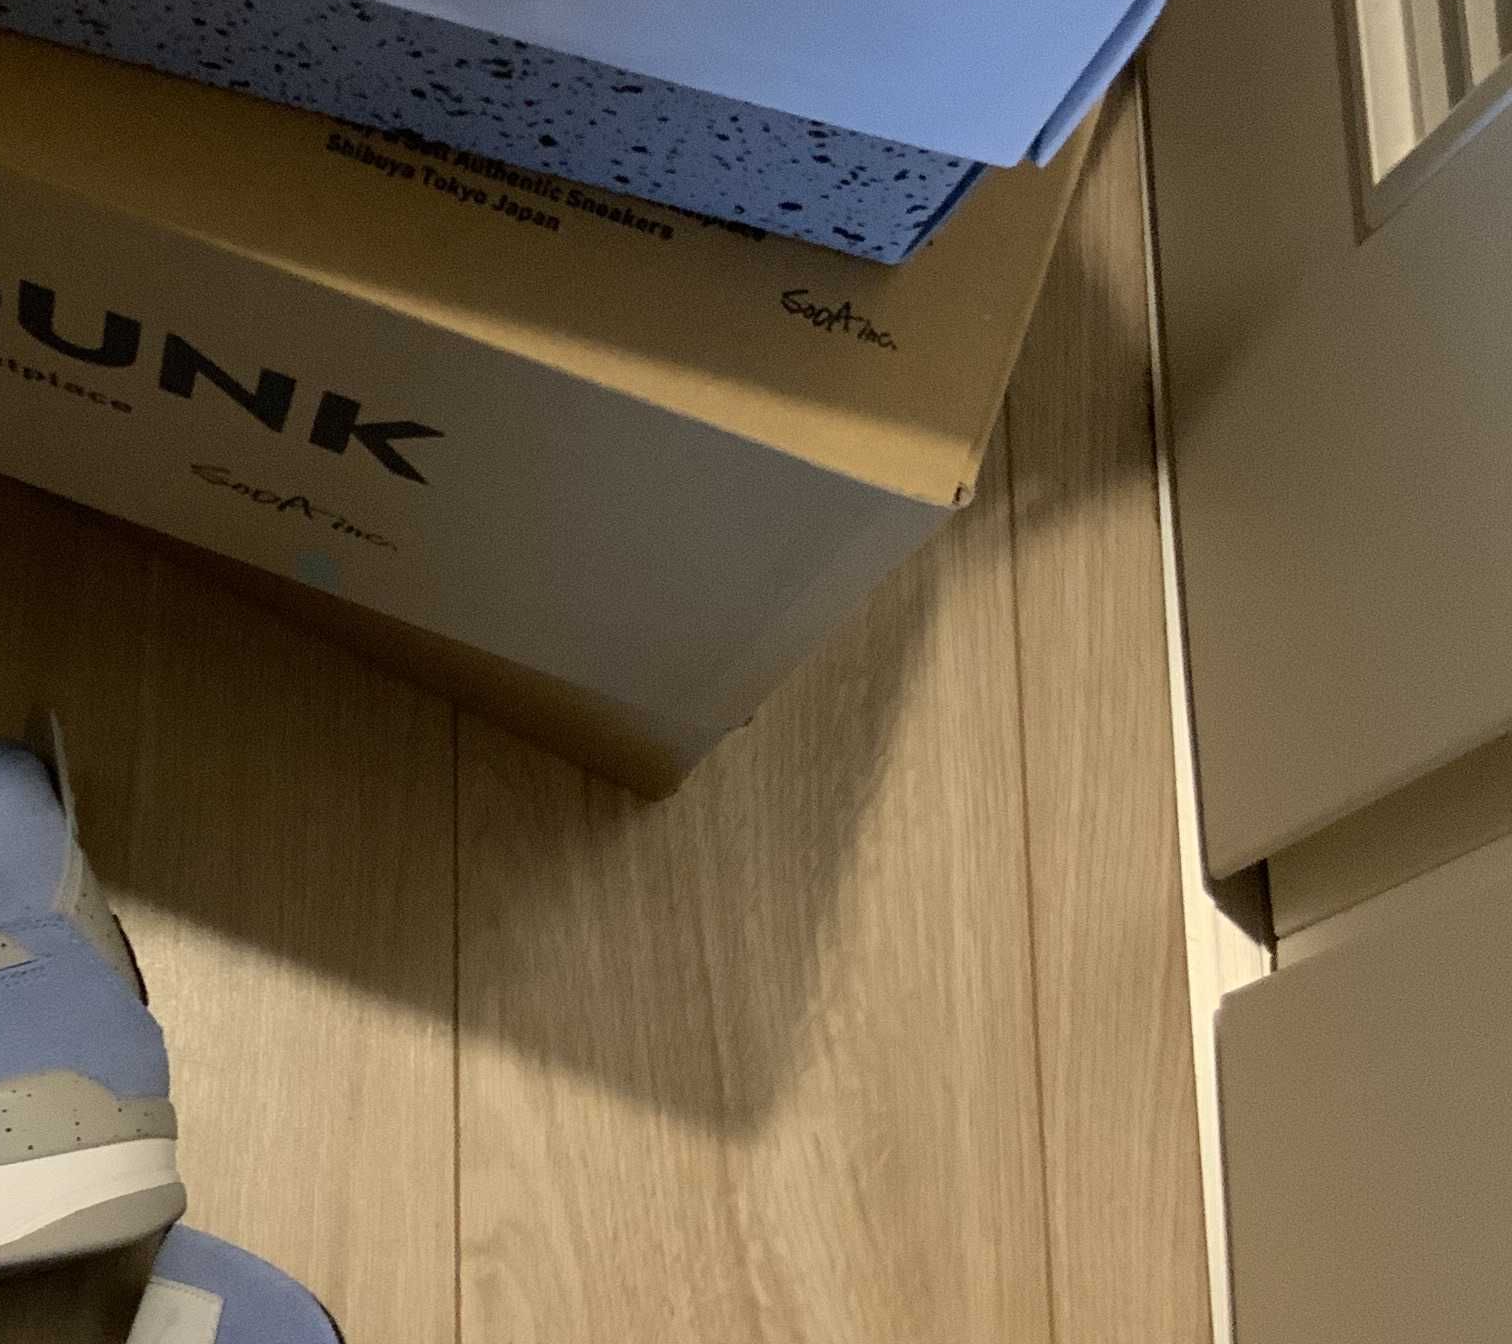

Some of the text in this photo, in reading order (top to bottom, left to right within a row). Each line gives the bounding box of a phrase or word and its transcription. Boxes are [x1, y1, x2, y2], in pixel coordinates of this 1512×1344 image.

[326, 131, 417, 182] Shibuya
[421, 164, 488, 206] Tokyo
[490, 193, 562, 233] Japan
[453, 150, 562, 204] Authentic
[563, 187, 676, 242] Sneakers
